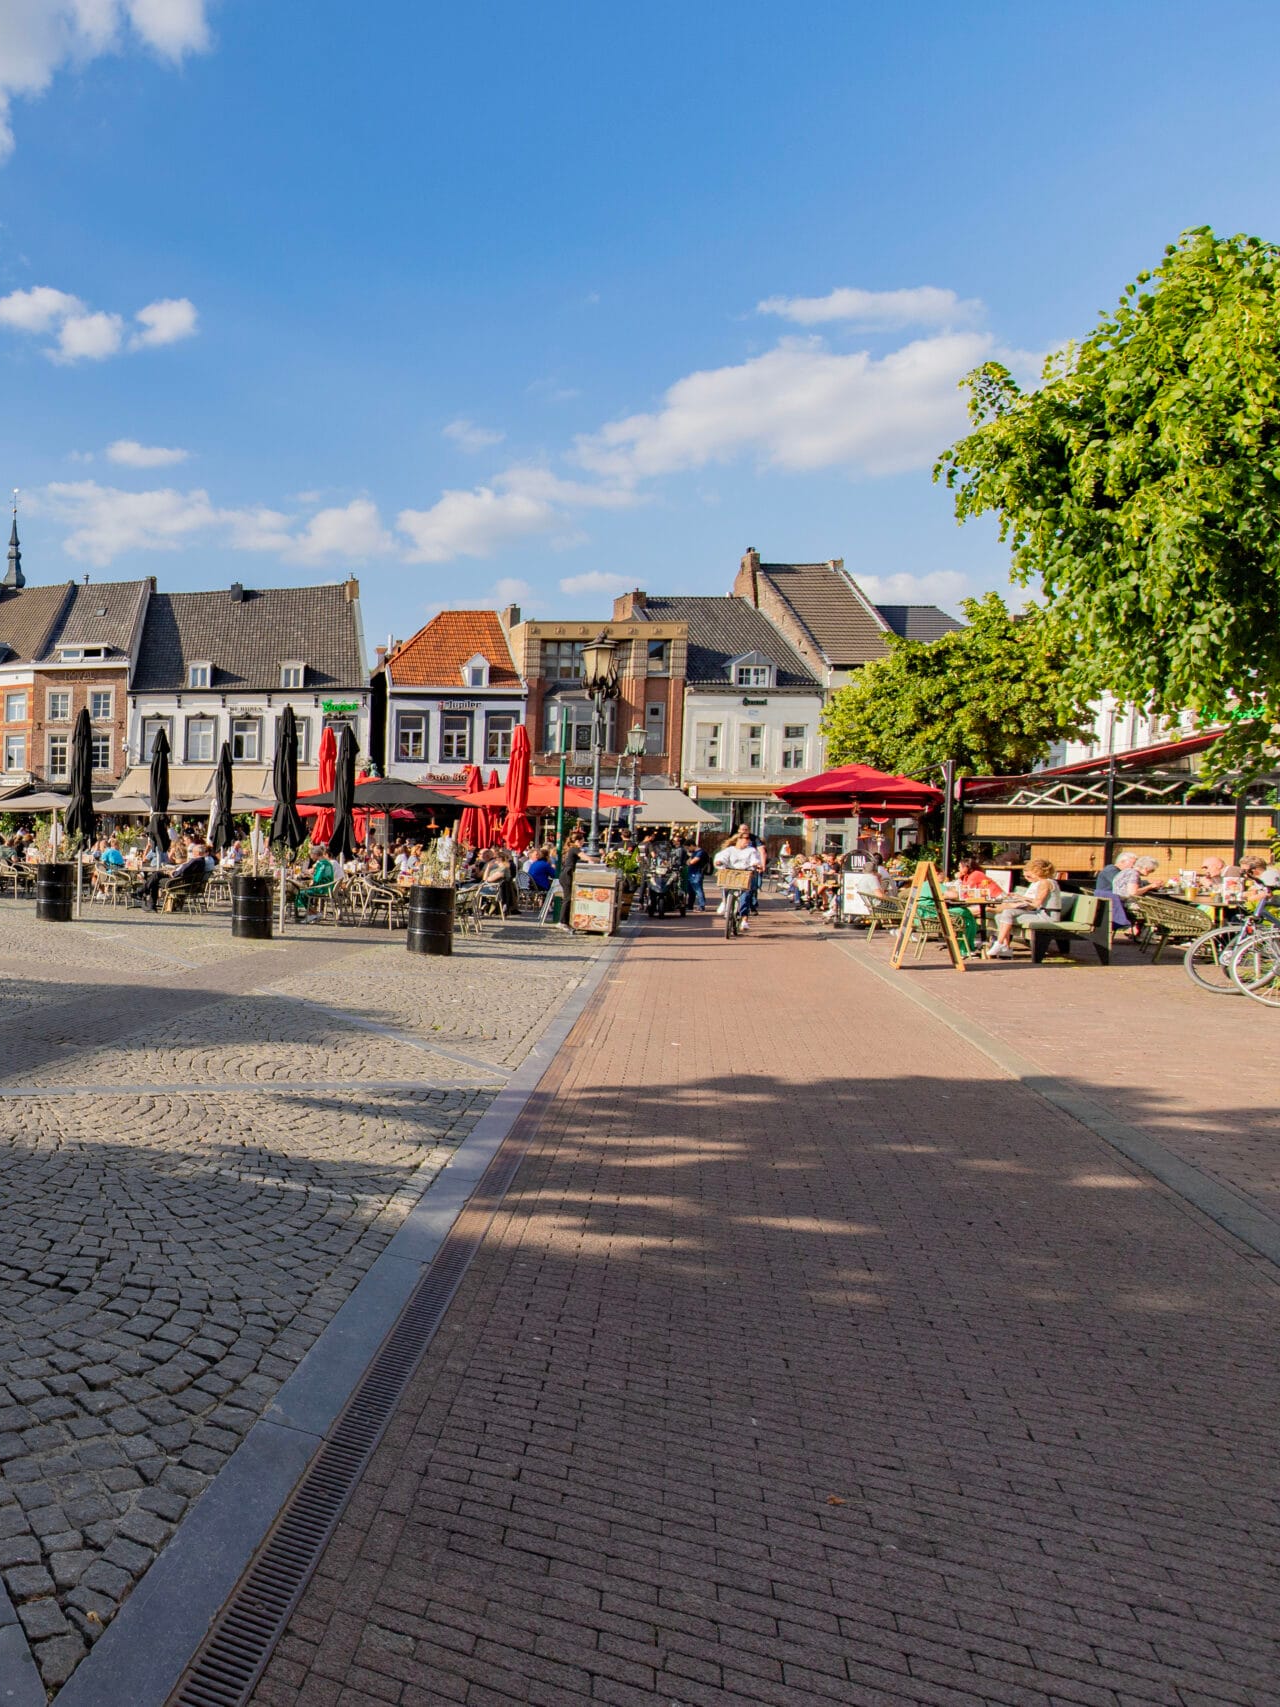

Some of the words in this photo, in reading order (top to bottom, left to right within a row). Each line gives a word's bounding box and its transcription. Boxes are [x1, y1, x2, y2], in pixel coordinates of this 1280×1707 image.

[64, 671, 95, 680] ROYAL
[446, 700, 482, 709] Jupiler
[566, 776, 593, 786] MED
[851, 855, 866, 867] LUNA
